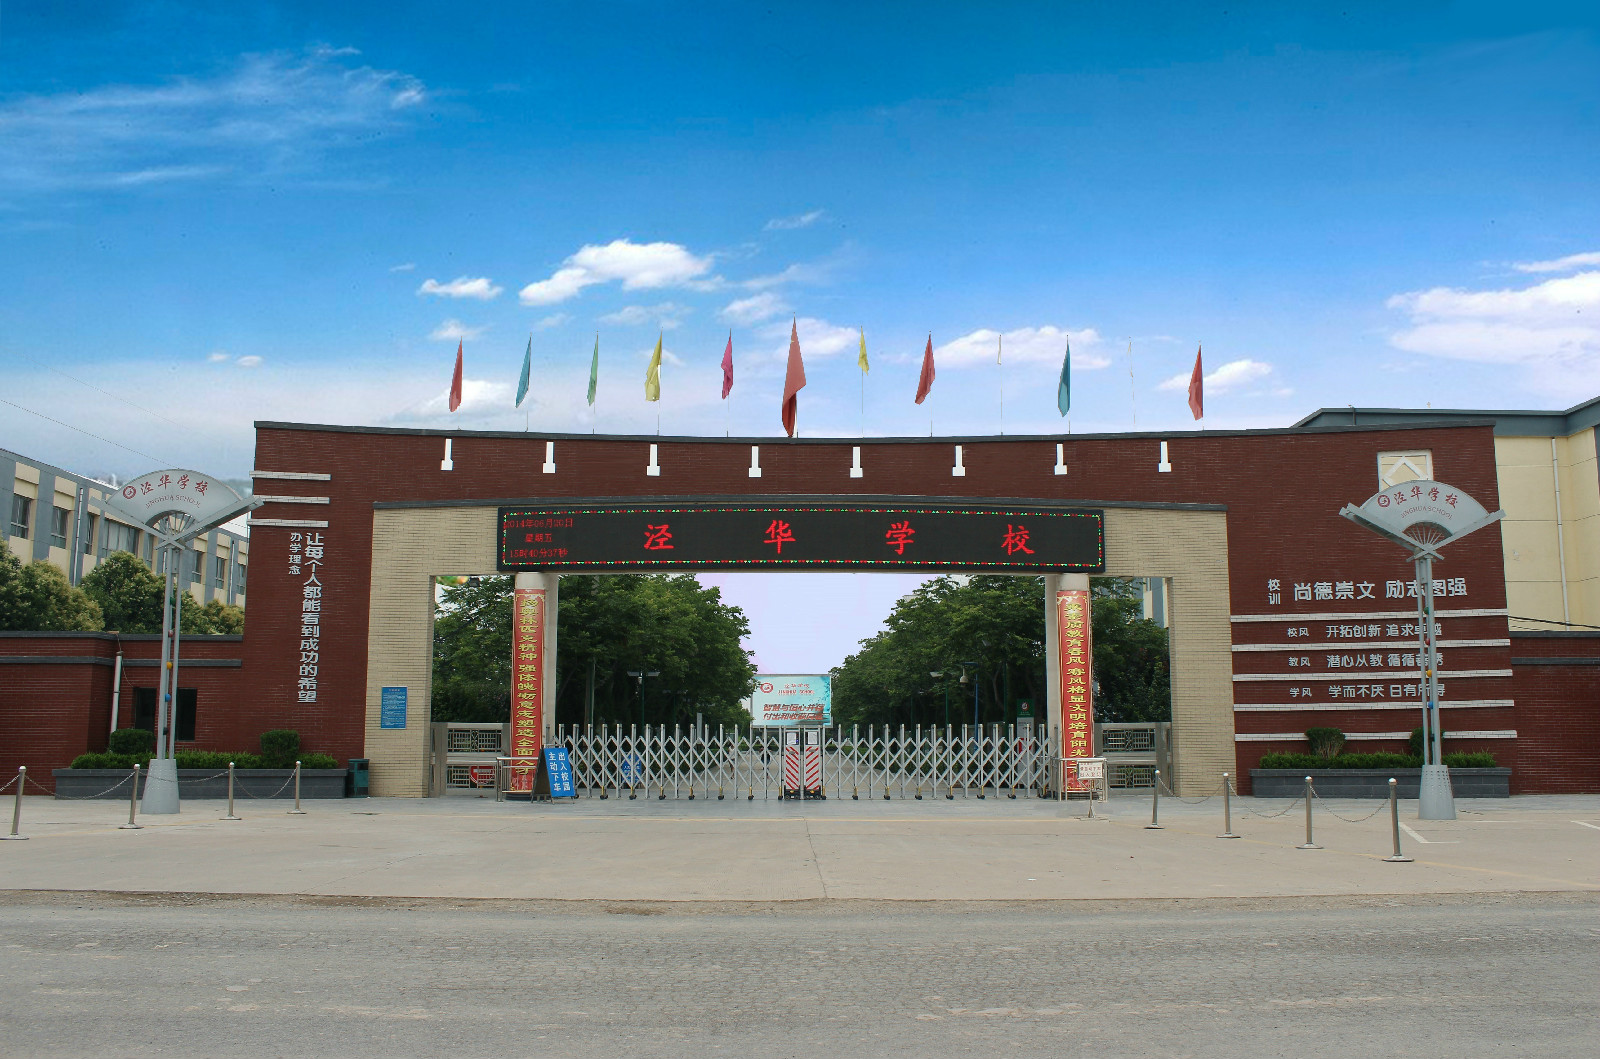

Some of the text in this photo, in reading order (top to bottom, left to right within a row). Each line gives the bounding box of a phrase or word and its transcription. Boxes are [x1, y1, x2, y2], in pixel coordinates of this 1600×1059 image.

[140, 474, 208, 496] 泾华学校
[1394, 485, 1459, 509] 泾华学校
[643, 519, 1036, 556] 泾华学校
[288, 532, 302, 575] 办学理念
[1267, 578, 1281, 605] 校训
[1293, 577, 1468, 601] 尚德崇文 励志图强
[297, 532, 325, 703] 让每个人都能看到成功的希望
[1287, 627, 1309, 638] 校风
[1326, 624, 1381, 638] 开拓创新
[1288, 656, 1311, 668] 教风
[1326, 654, 1383, 668] 潜心从教
[1289, 686, 1312, 698] 学风
[1328, 684, 1385, 699] 学而不厌
[548, 752, 562, 791] 主动下车
[558, 751, 571, 791] 出入校园
